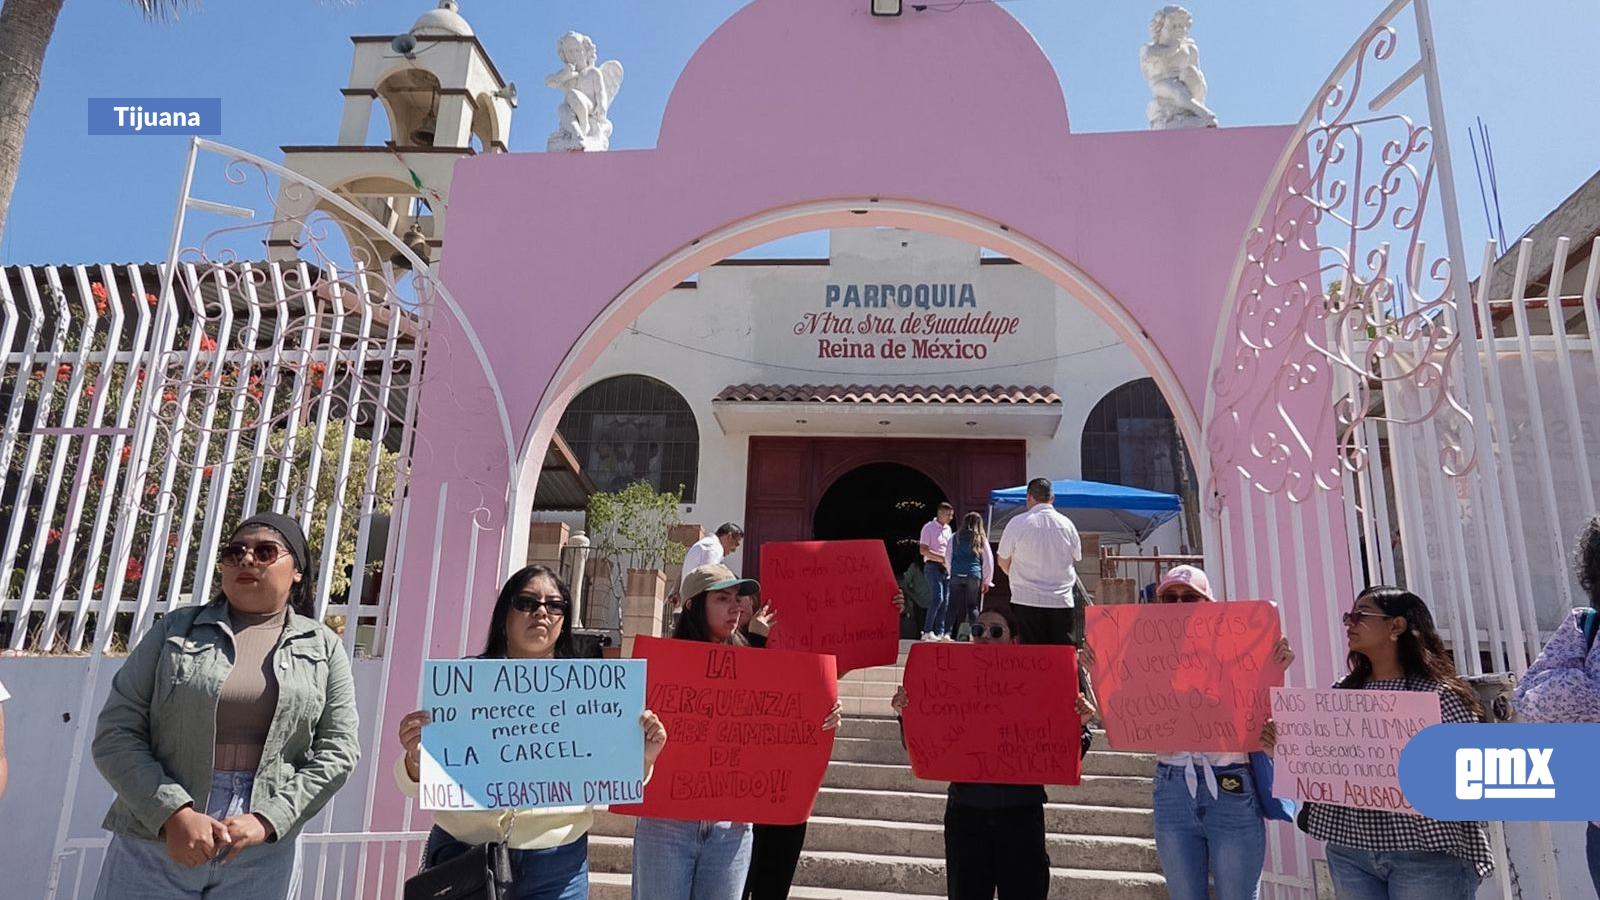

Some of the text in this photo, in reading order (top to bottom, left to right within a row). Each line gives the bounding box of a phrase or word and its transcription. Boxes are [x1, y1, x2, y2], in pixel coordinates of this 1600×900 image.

[793, 311, 1020, 343] Ntra. Sra. de Guadalupe
[818, 337, 988, 360] Reina de México
[706, 650, 737, 680] LA
[1105, 649, 1132, 682] la
[1233, 641, 1259, 672] la
[432, 664, 627, 696] UN ABUSADOR
[432, 699, 623, 723] no merece el altar,
[1274, 691, 1397, 712] ¿NOS RECUERDAS?
[492, 721, 560, 739] merece
[716, 719, 819, 746] CAMBIAR
[1313, 719, 1330, 737] las
[1333, 717, 1354, 737] EX
[444, 740, 593, 767] LA CARCEL.
[709, 747, 741, 768] DE
[1277, 743, 1301, 762] que
[1368, 746, 1385, 759] no
[1288, 759, 1396, 778] conocido nunca
[423, 779, 643, 809] NOEL SEBASTIAN D'MELLO
[670, 769, 792, 803] BANDO!!
[1296, 776, 1413, 810] NOEL ABUSADO
